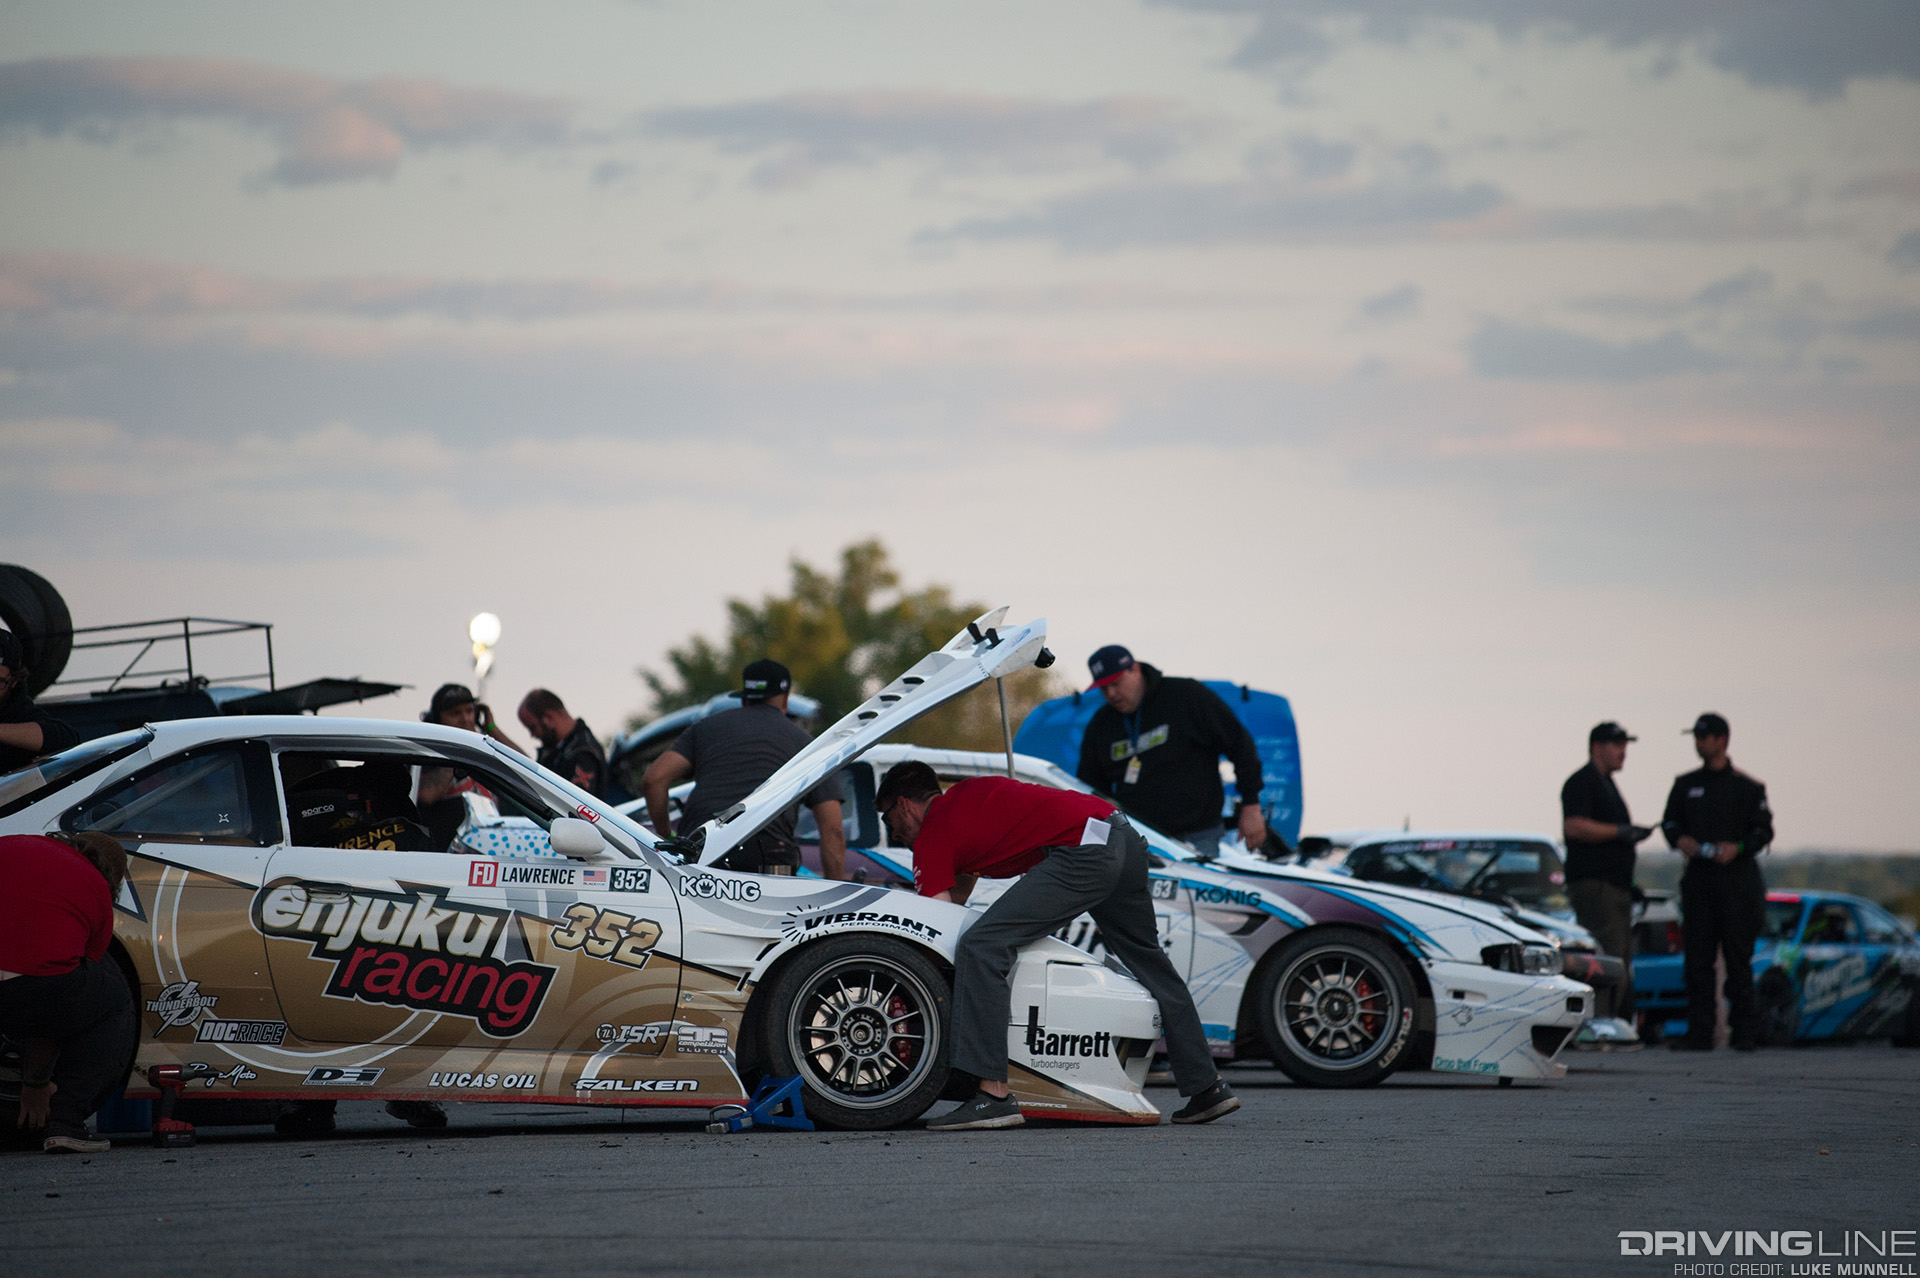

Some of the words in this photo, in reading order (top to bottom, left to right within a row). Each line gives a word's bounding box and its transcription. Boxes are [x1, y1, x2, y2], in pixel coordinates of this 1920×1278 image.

[472, 863, 496, 885] FD
[501, 867, 576, 885] LAWRENCE
[613, 869, 648, 890] 352
[679, 873, 761, 902] KÖNIG
[262, 884, 499, 958] enjuku
[804, 912, 942, 940] VIBRANT
[551, 902, 665, 972] 352
[841, 921, 936, 944] PERFORMANCE
[339, 946, 543, 1028] racing
[146, 996, 219, 1013] THUNDERBOLT
[199, 1021, 285, 1043] DOCRACE
[615, 1025, 660, 1044] ISR
[1029, 1028, 1110, 1057] Garrett
[678, 1047, 726, 1055] CLUTCH
[1030, 1059, 1080, 1071] Turbochargers
[428, 1072, 499, 1088] LUCAS
[504, 1073, 537, 1089] OIL
[572, 1078, 700, 1092] FALKEN
